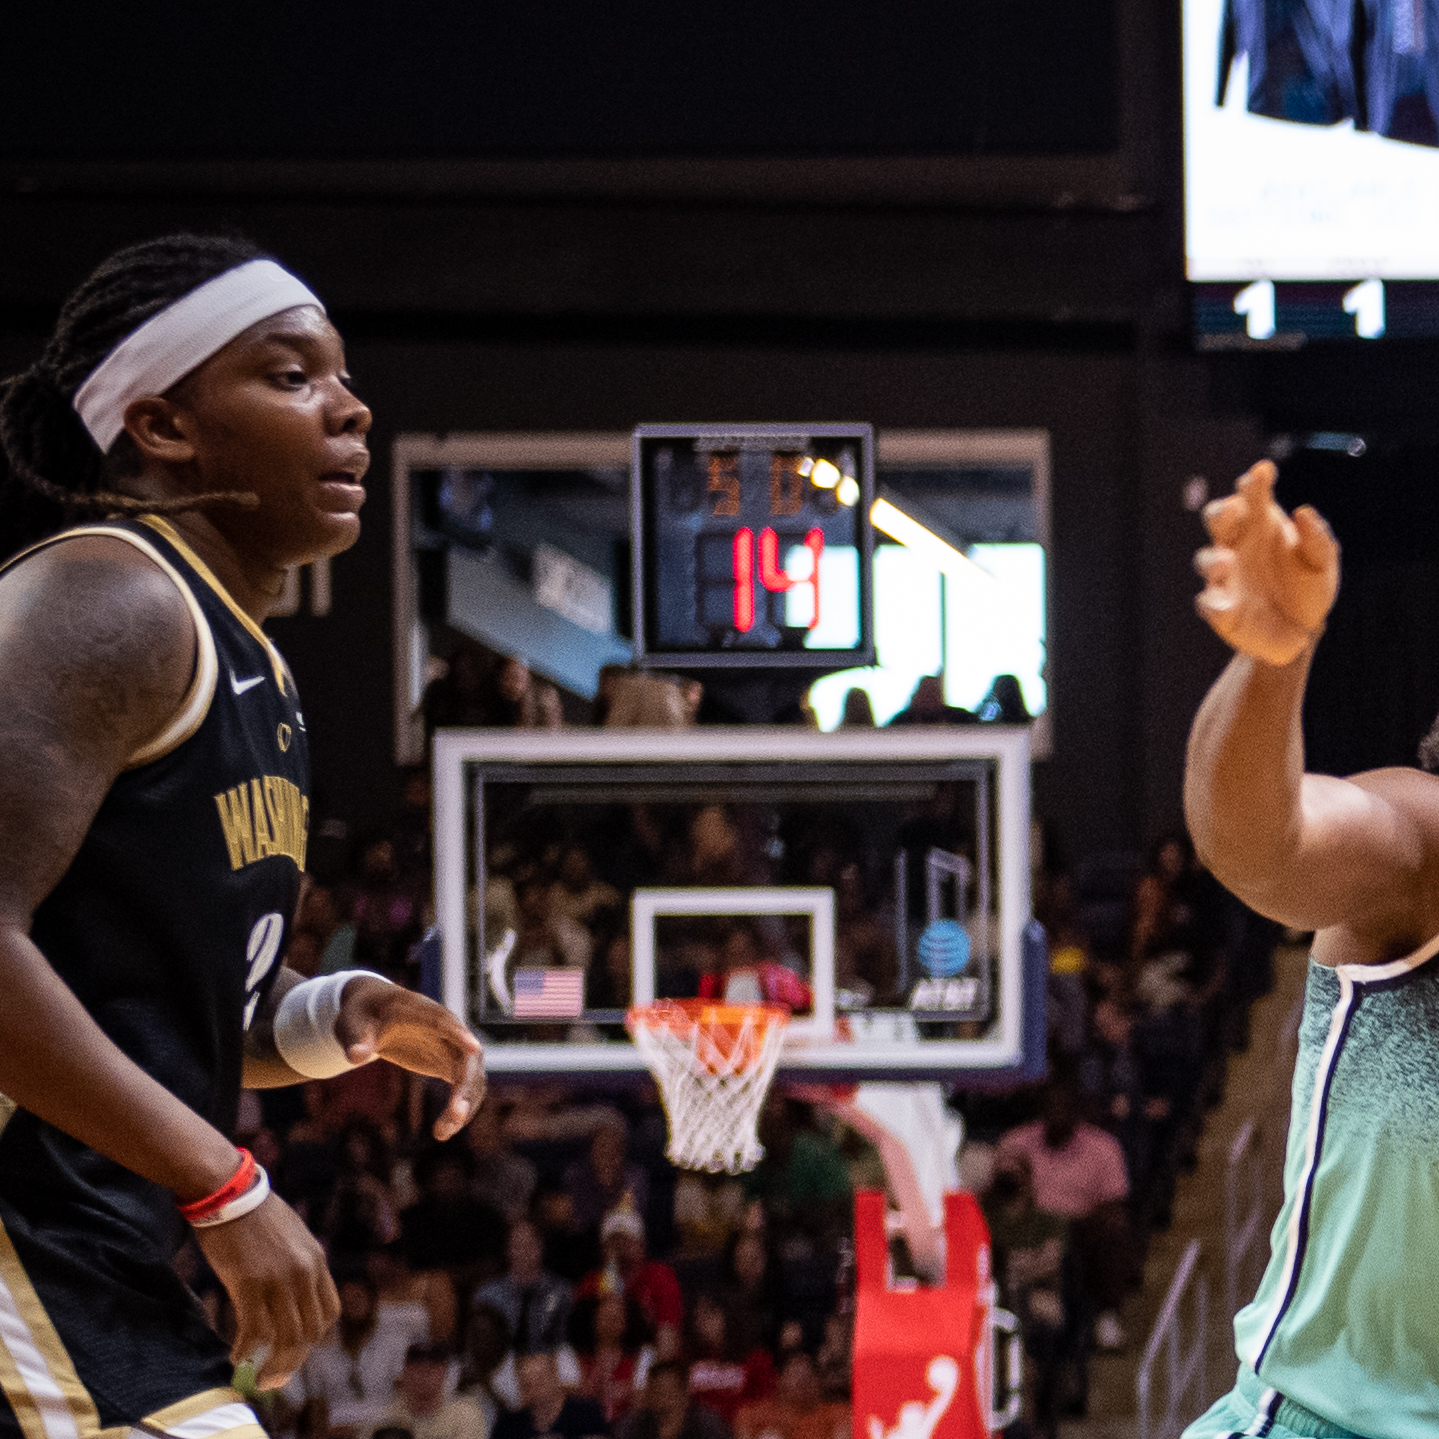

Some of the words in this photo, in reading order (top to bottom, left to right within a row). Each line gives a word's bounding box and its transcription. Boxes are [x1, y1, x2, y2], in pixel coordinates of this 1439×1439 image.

[1234, 281, 1276, 340] 1
[1343, 281, 1386, 340] 1
[733, 526, 824, 633] 14
